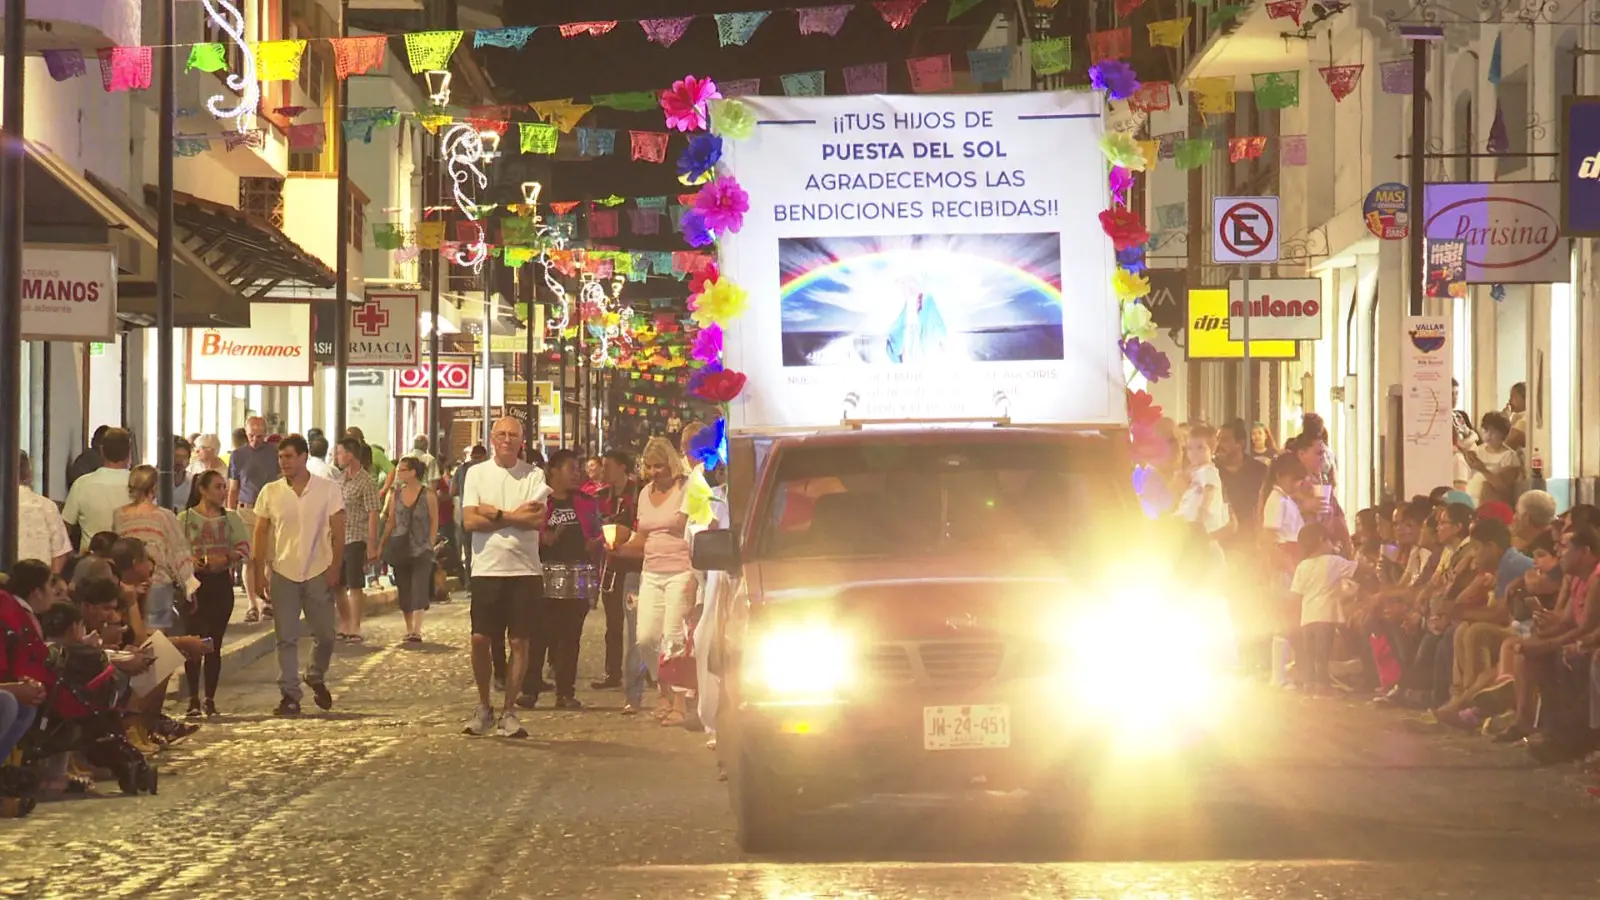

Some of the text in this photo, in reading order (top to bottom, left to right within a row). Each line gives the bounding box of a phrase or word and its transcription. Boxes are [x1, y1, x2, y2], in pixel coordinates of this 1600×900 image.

[894, 111, 955, 130] HIJOS
[964, 110, 994, 128] DE
[822, 140, 1007, 161] PUESTA DEL SOL
[805, 169, 1026, 191] AGRADECEMOS LAS
[774, 199, 1059, 222] BENDICIONES RECIBIDAS!!
[1455, 214, 1549, 246] Parisina
[22, 279, 100, 302] MANOS
[1230, 294, 1320, 318] milano
[400, 362, 467, 388] OXXO
